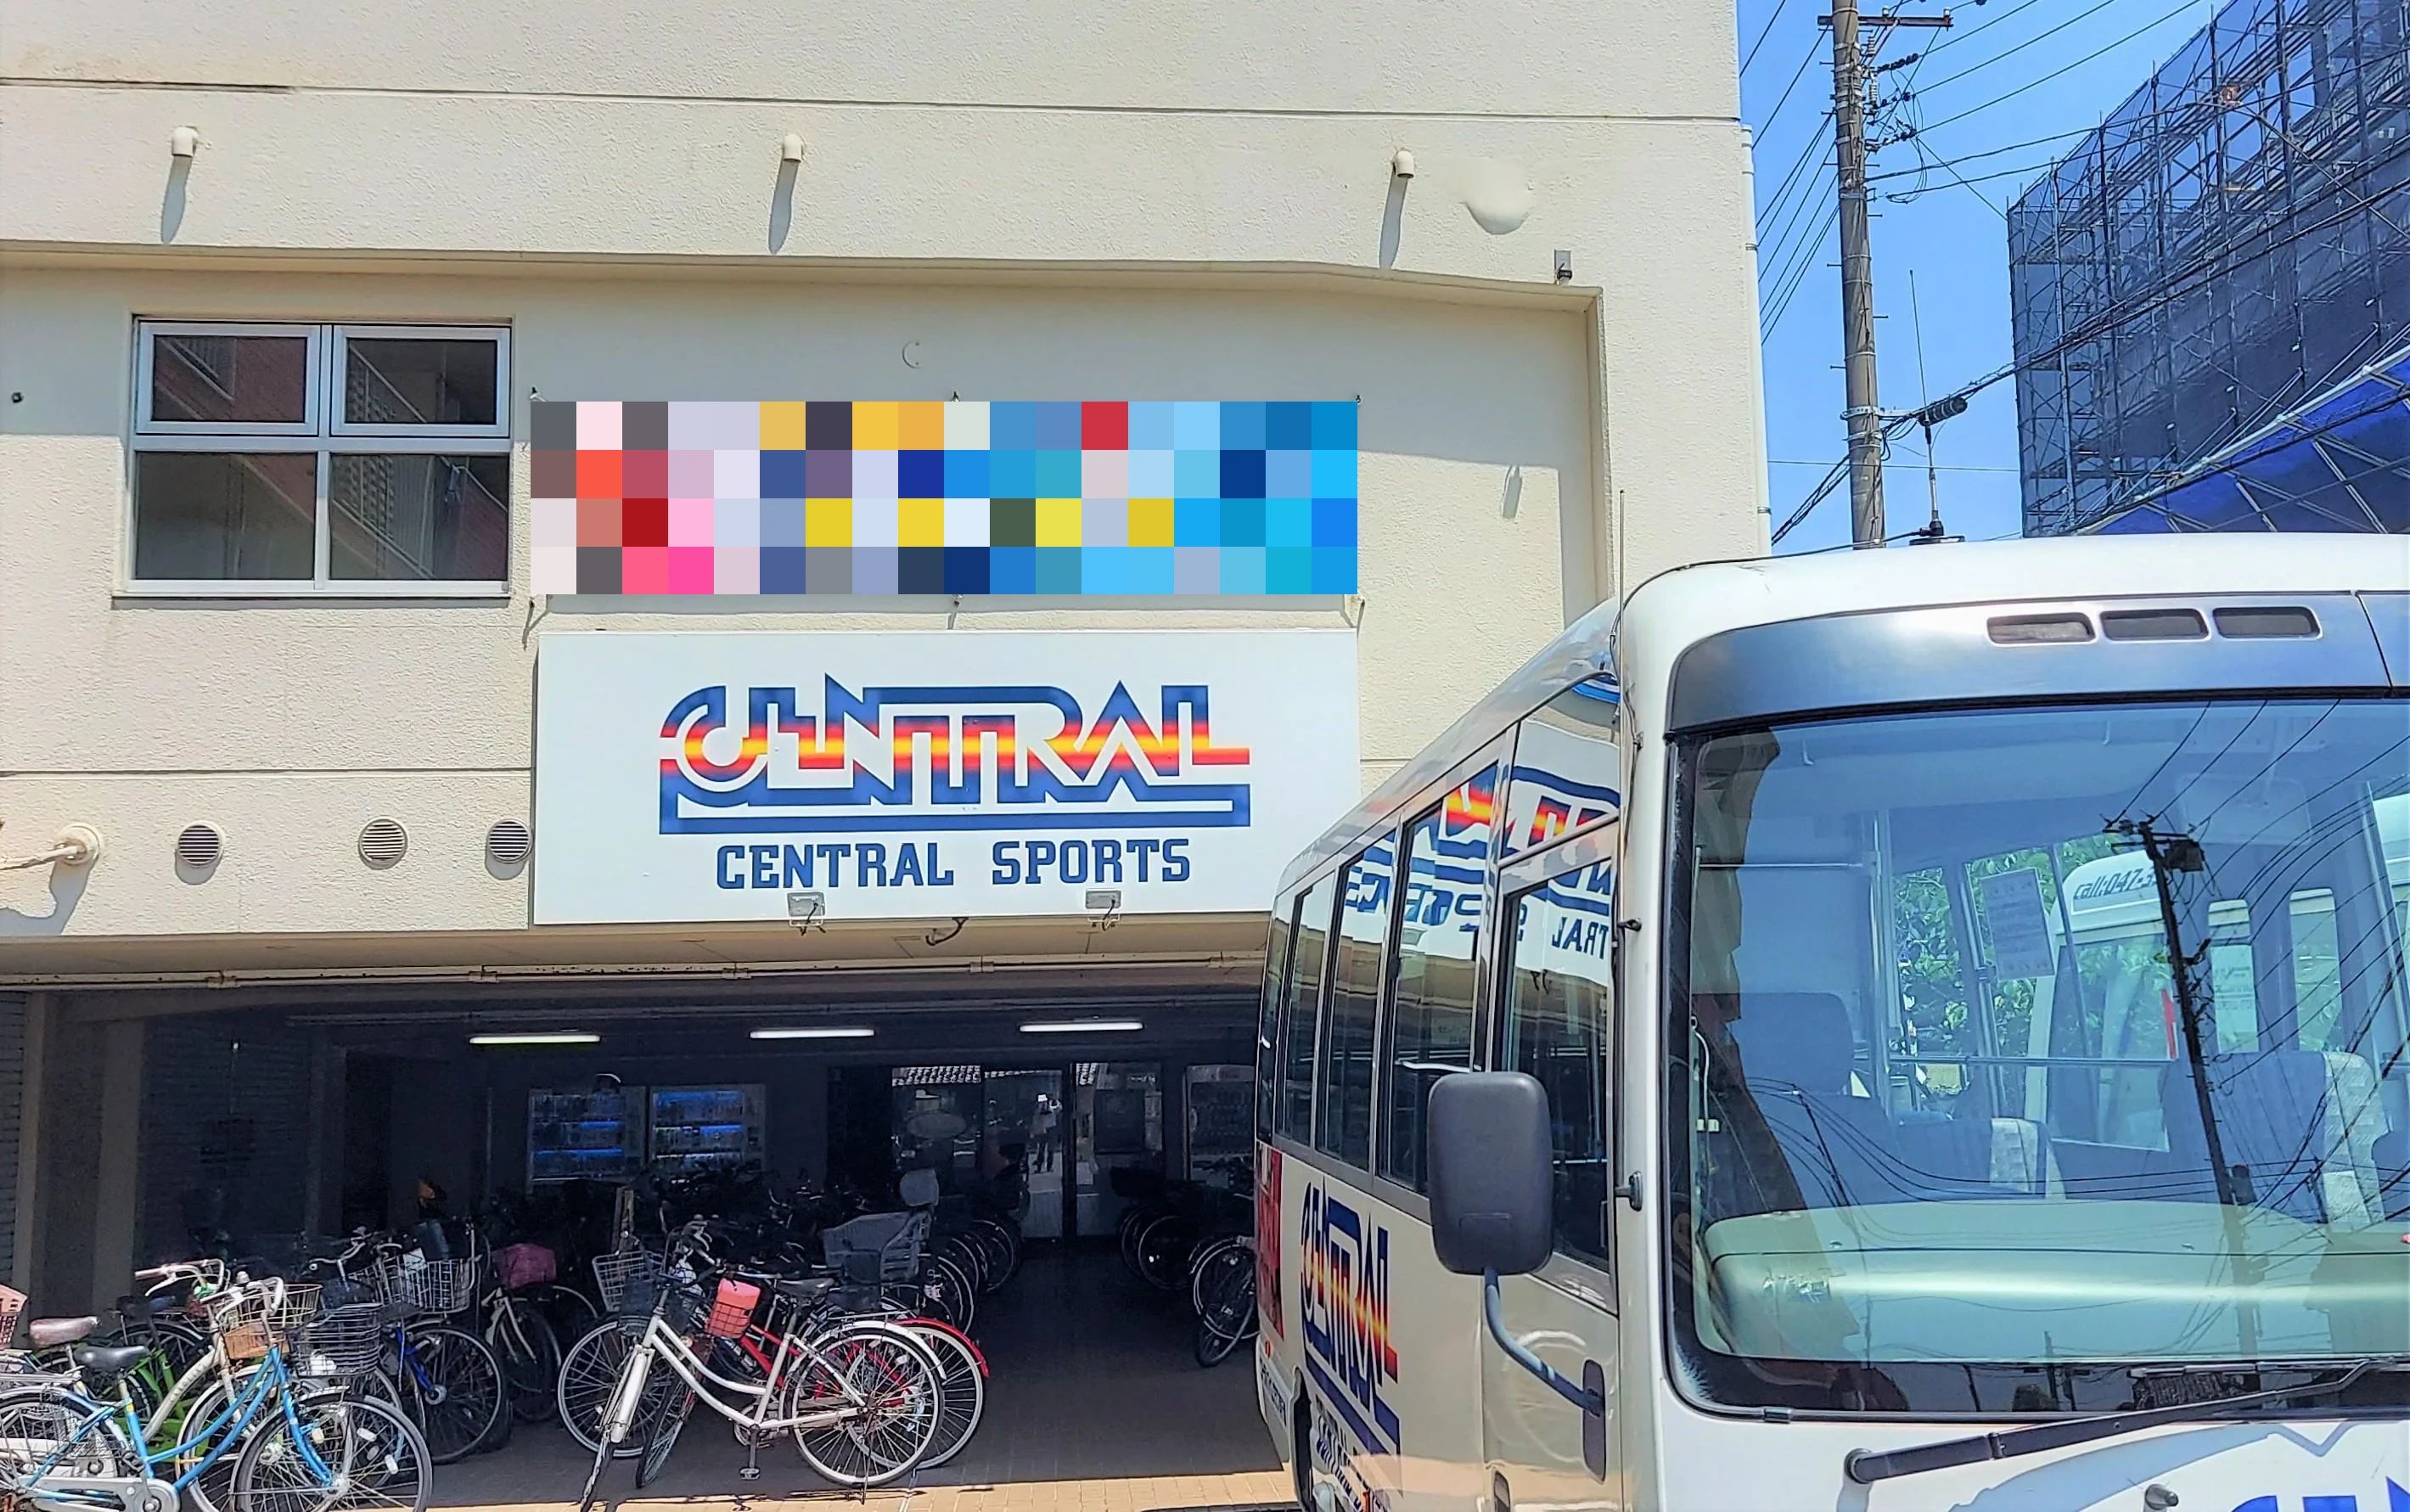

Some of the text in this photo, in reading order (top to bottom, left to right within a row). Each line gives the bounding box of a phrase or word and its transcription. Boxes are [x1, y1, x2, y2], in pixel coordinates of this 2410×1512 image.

[660, 672, 1250, 835] CENTRAL
[716, 838, 1189, 890] CENTRAL SPORTS
[1301, 1176, 1402, 1490] CENTRAL
